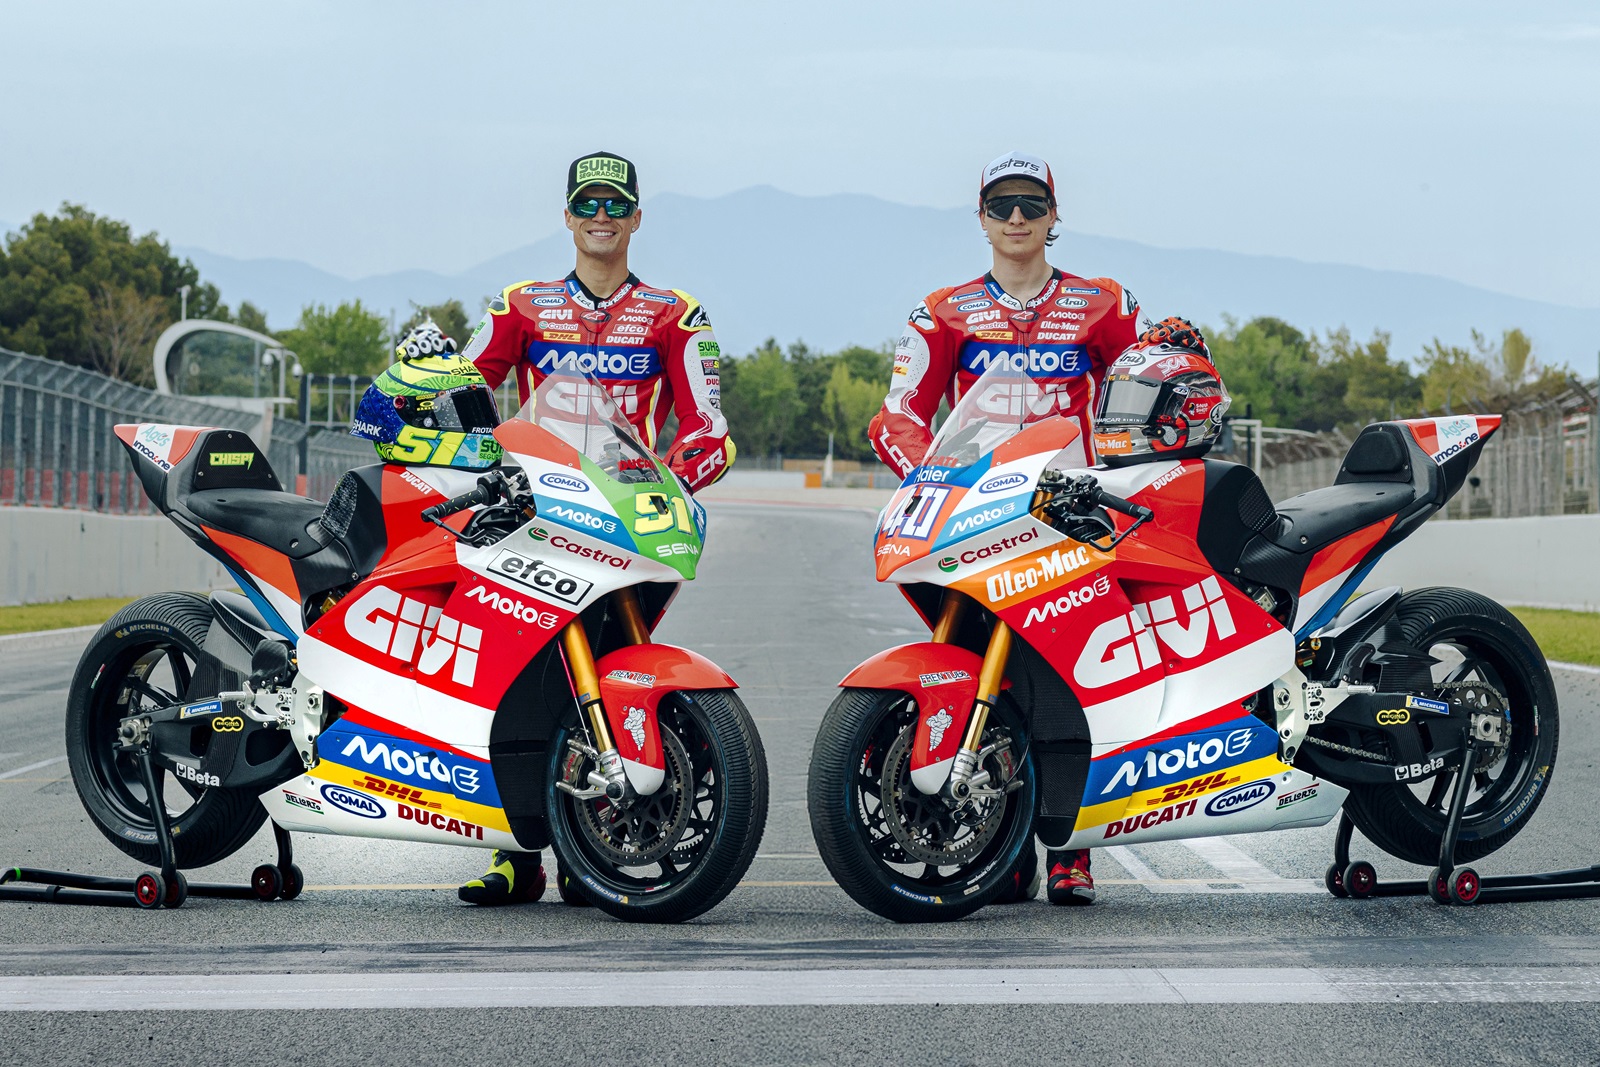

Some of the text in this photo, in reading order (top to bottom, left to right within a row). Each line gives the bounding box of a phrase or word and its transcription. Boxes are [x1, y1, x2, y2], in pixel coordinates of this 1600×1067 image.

[579, 171, 625, 180] SEGURADORA
[989, 158, 1040, 176] astars
[624, 307, 655, 316] SHARK
[962, 302, 988, 310] COMAL
[1062, 298, 1084, 306] Arai
[538, 309, 573, 320] GIVI
[965, 310, 1001, 324] GIVI
[548, 322, 578, 331] Castrol
[617, 324, 644, 333] efco
[977, 321, 1008, 330] Castrol
[1037, 331, 1076, 340] DUCATI
[1040, 321, 1080, 331] Oleo-Mac
[606, 335, 644, 345] DUCATI
[546, 381, 638, 419] GIVI
[976, 383, 1071, 416] GIVI
[392, 425, 467, 465] 51
[879, 425, 915, 479] LCR
[682, 447, 726, 488] LCR
[1151, 465, 1187, 491] DUCATI
[400, 471, 433, 495] DUCATI
[547, 475, 582, 489] COMAL
[986, 476, 1021, 490] COMAL
[633, 491, 692, 536] 51
[550, 535, 632, 571] Castrol
[656, 542, 699, 558] SENA
[877, 543, 911, 557] SENA
[960, 527, 1039, 564] Castrol
[501, 556, 578, 596] efco
[986, 546, 1090, 603] Oleo-Mac
[129, 623, 170, 633] MICHELIN
[344, 585, 483, 688] GIVI
[1073, 574, 1237, 689] GIVI
[191, 704, 218, 713] MICHELIN
[1418, 701, 1446, 711] MICHELIN
[187, 766, 220, 787] Beta
[1410, 757, 1444, 778] Beta
[363, 775, 430, 806] DHL
[1159, 772, 1230, 803] DHL
[1216, 786, 1265, 809] COMAL
[330, 790, 377, 813] COMAL
[1503, 783, 1538, 824] MICHELIN
[397, 803, 484, 841] DUCATI
[1103, 798, 1198, 840] DUCATI
[125, 829, 158, 840] CHELIN
[893, 885, 928, 902] MICHELIN
